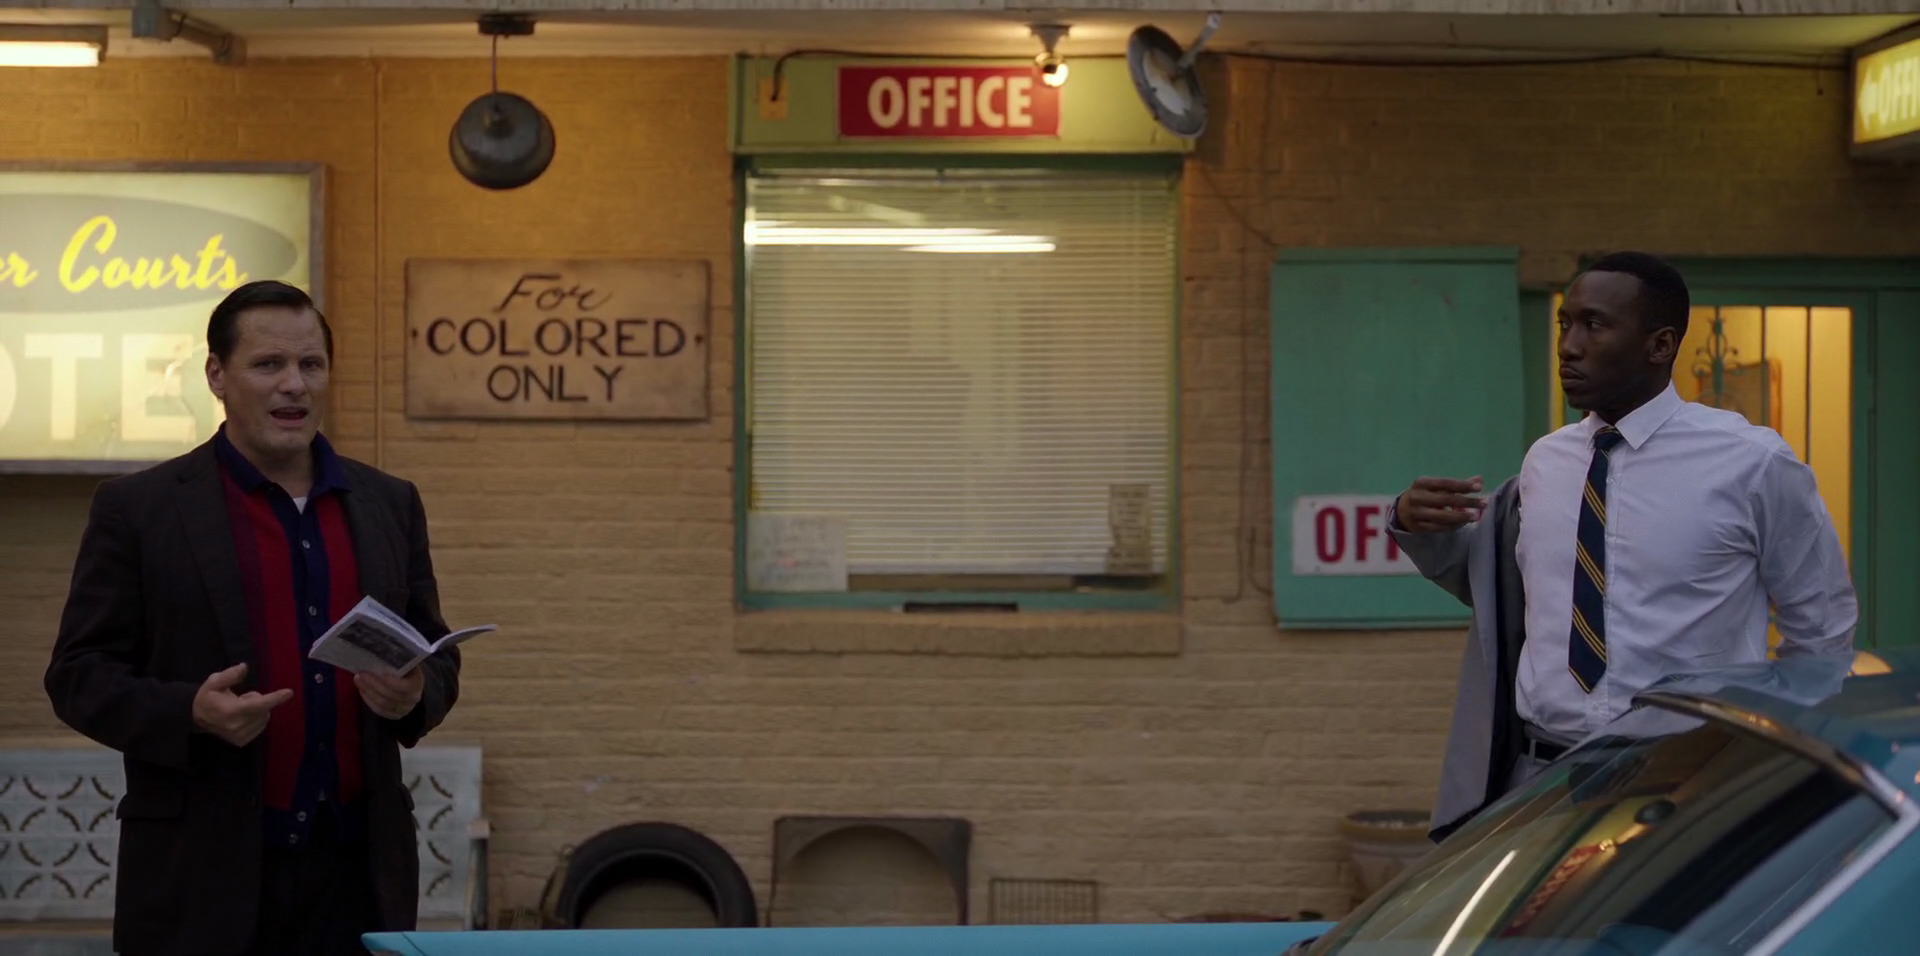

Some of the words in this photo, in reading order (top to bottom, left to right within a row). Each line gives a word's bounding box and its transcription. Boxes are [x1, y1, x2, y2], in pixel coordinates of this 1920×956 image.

[867, 76, 1034, 128] OFFICE
[59, 215, 249, 293] Courts
[492, 272, 612, 314] For
[426, 317, 687, 358] COLORED
[486, 364, 623, 403] ONLY
